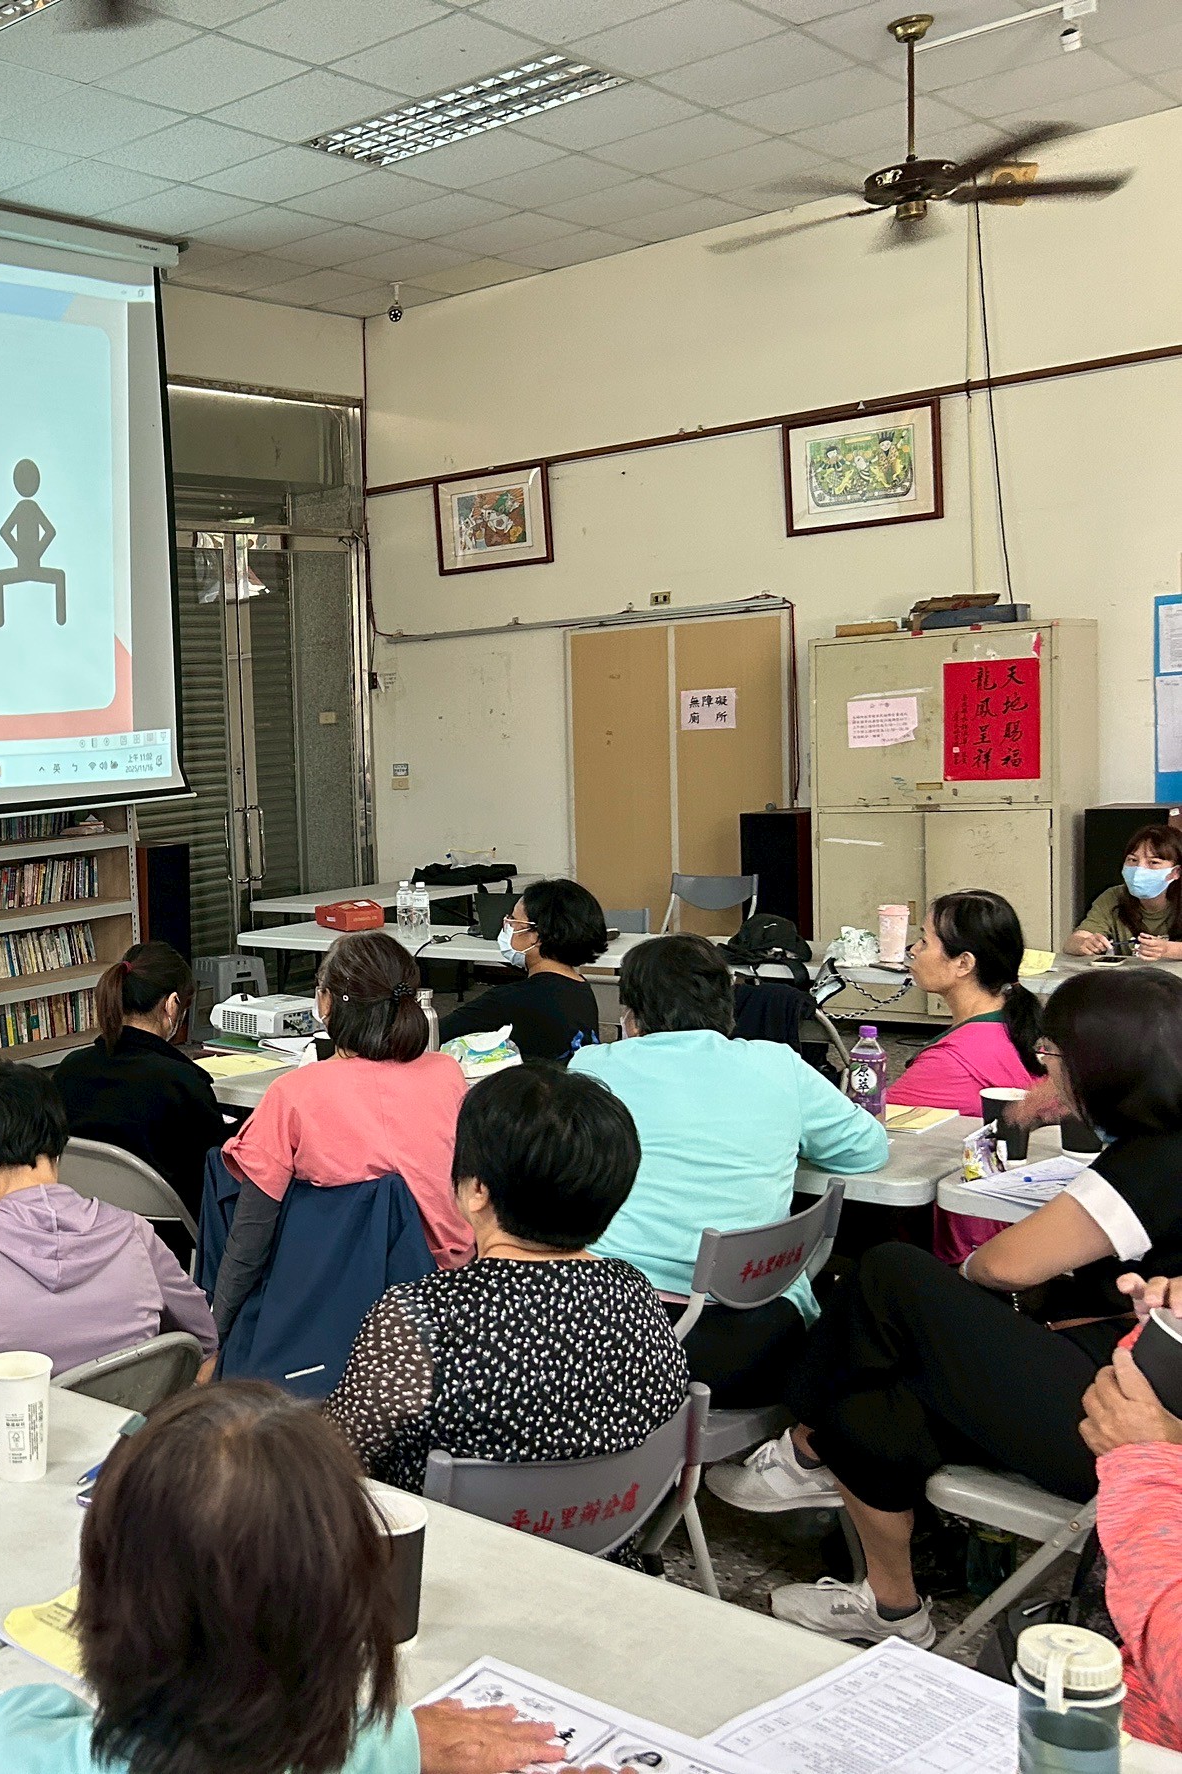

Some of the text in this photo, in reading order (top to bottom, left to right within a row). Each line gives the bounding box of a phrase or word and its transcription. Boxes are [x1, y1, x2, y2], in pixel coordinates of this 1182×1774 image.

[689, 694, 728, 709] 無障礙
[999, 665, 1029, 767] 天地賜福
[970, 666, 998, 772] 龍鳳呈祥
[53, 763, 61, 774] 英
[854, 1063, 870, 1094] 原萃
